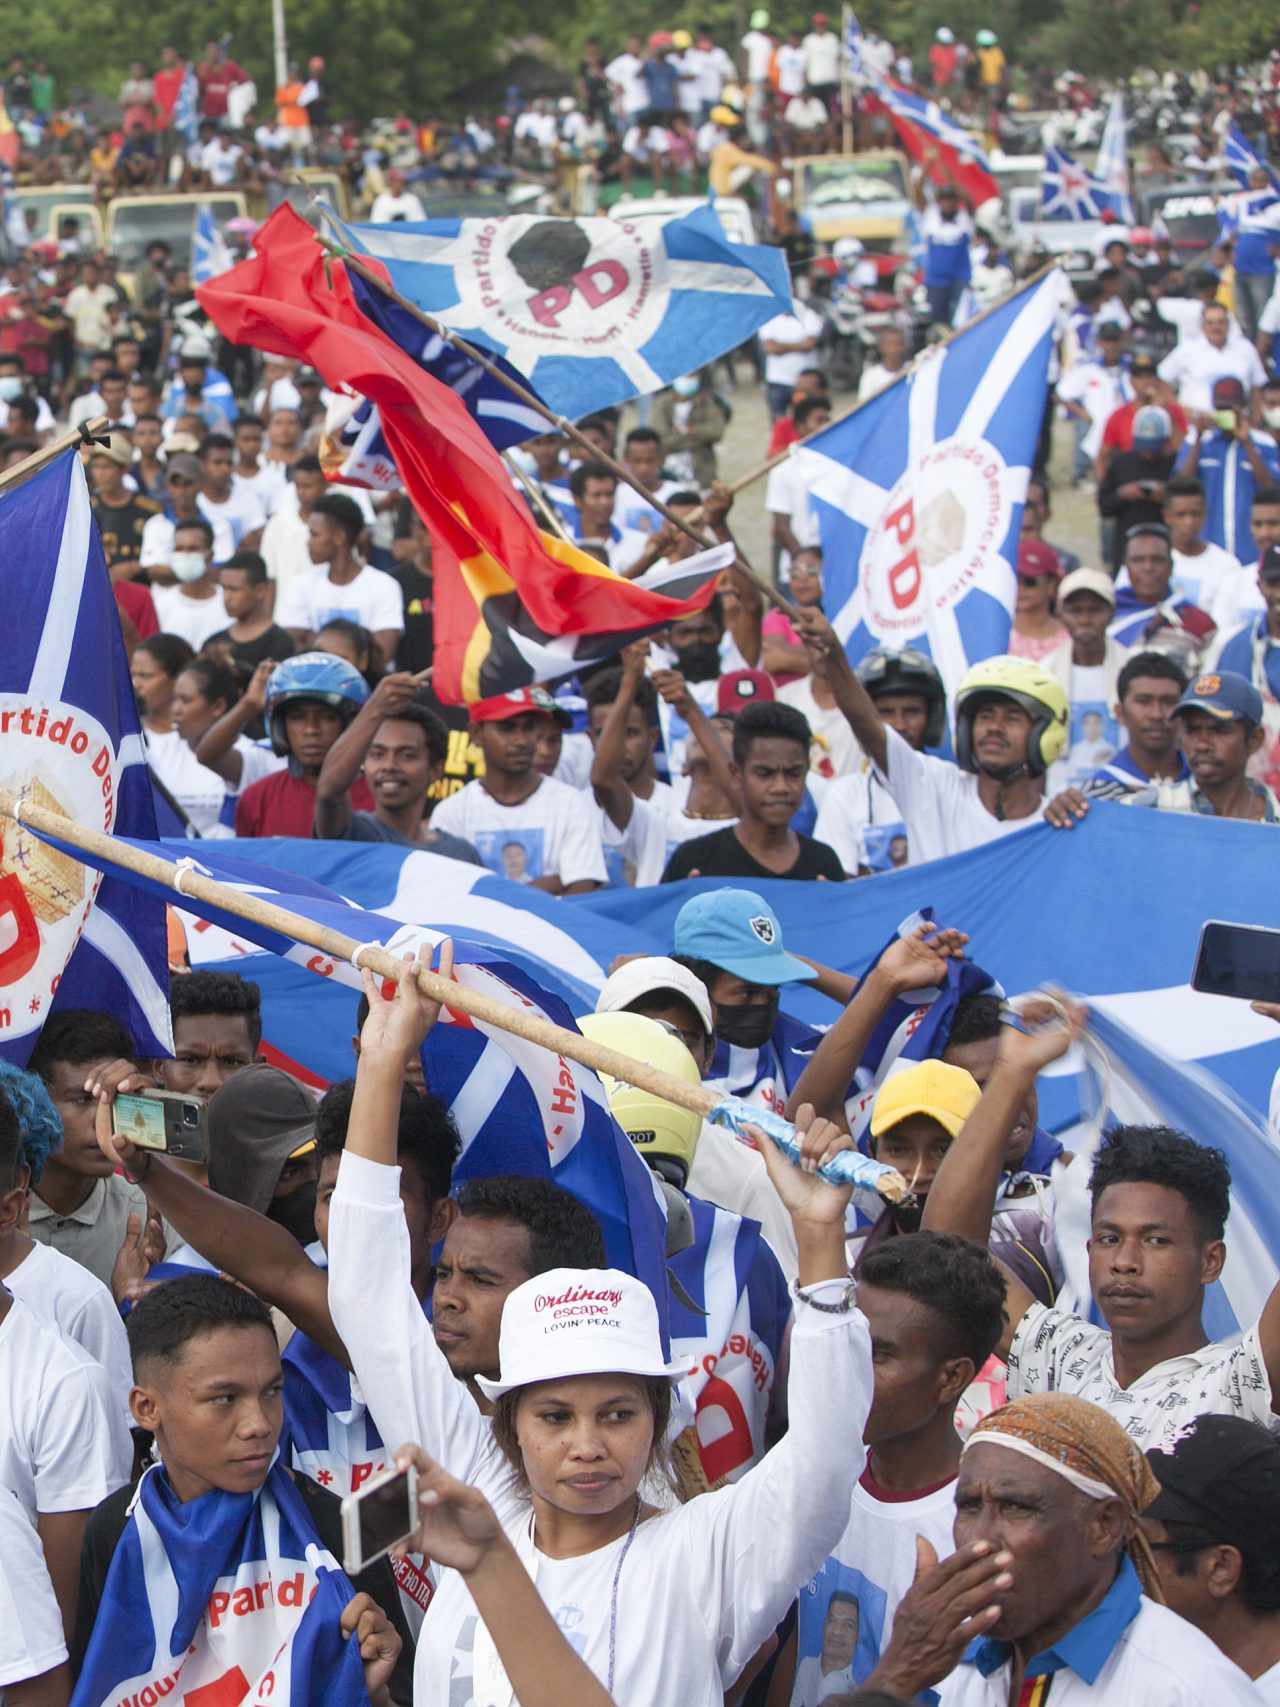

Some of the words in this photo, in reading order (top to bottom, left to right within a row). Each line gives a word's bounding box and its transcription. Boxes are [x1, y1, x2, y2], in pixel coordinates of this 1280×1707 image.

[472, 224, 501, 308] Partido
[525, 258, 631, 328] PD
[883, 496, 923, 611] PD
[534, 1284, 623, 1313] Ordinary
[553, 1304, 609, 1319] escape
[587, 1318, 622, 1328] PEACE
[403, 1569, 419, 1593] HO
[417, 1582, 431, 1608] ITA
